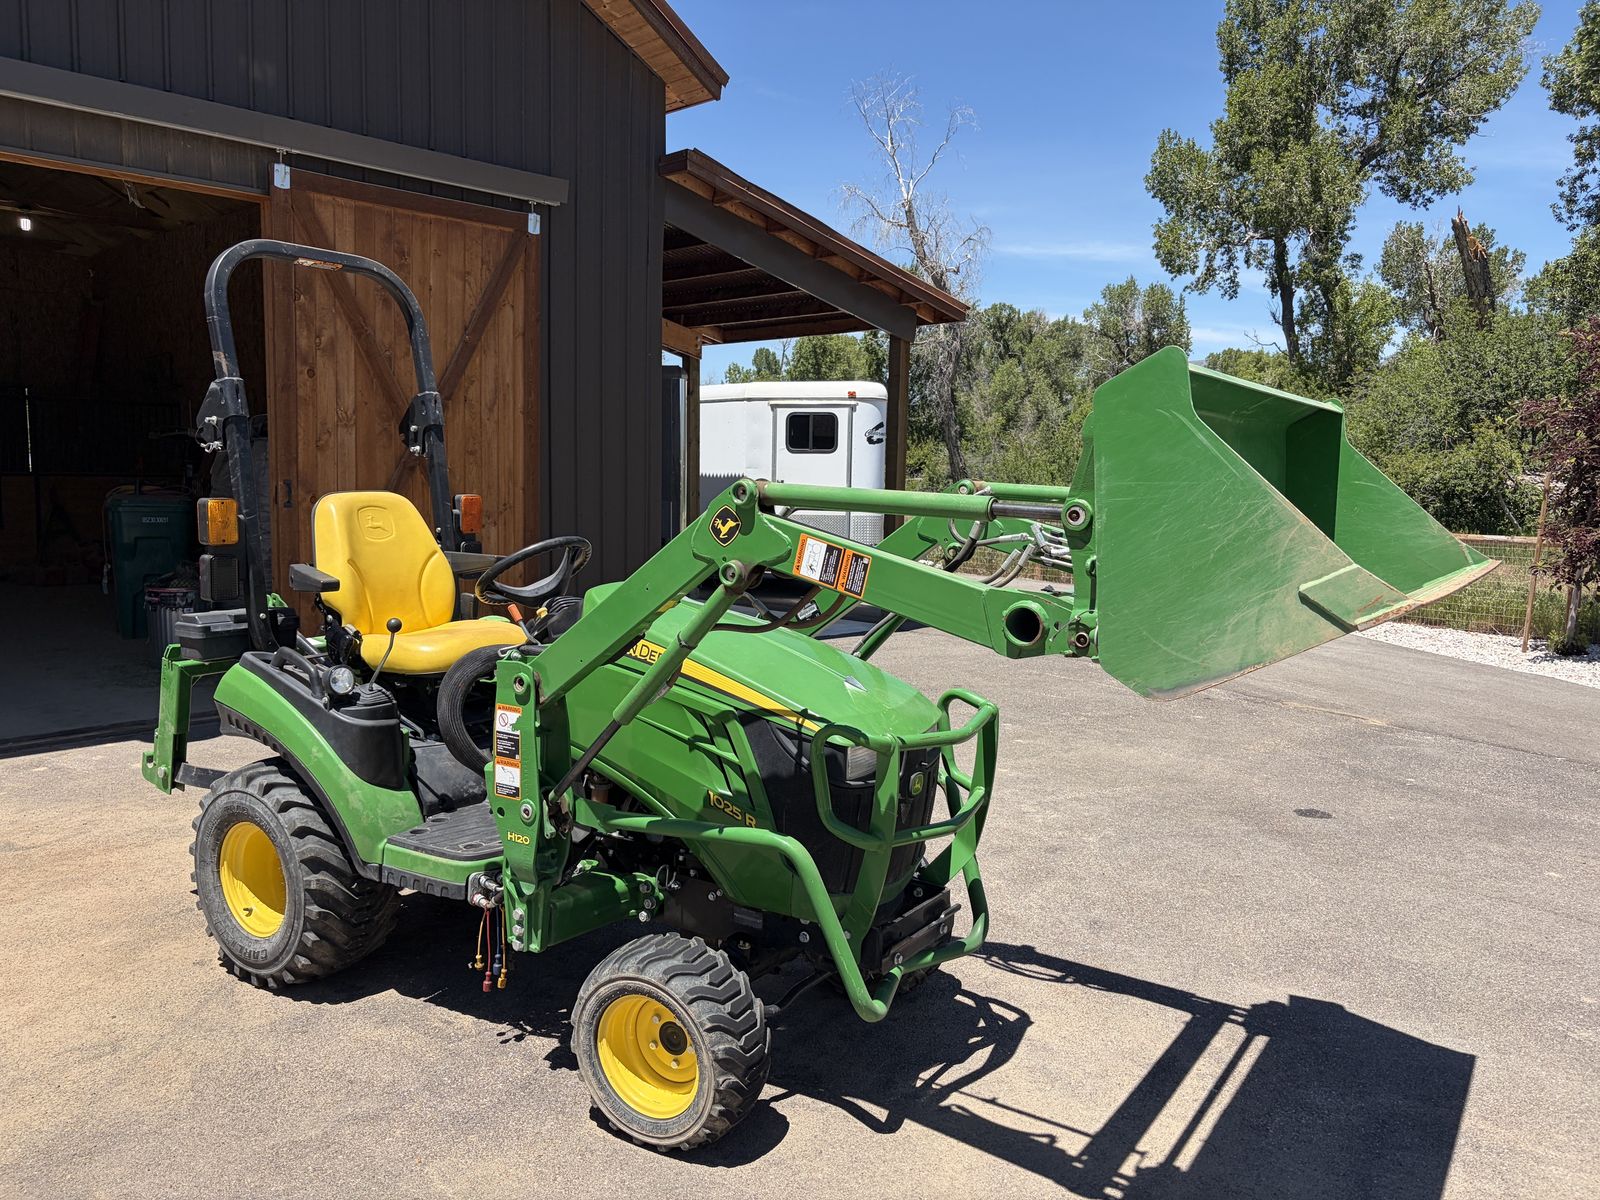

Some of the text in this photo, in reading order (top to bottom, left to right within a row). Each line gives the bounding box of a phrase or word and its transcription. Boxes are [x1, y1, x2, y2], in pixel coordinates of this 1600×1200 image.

[797, 539, 806, 563] WARNING
[843, 554, 851, 580] WARNING
[707, 789, 757, 828] 1025 R
[507, 831, 530, 845] H120
